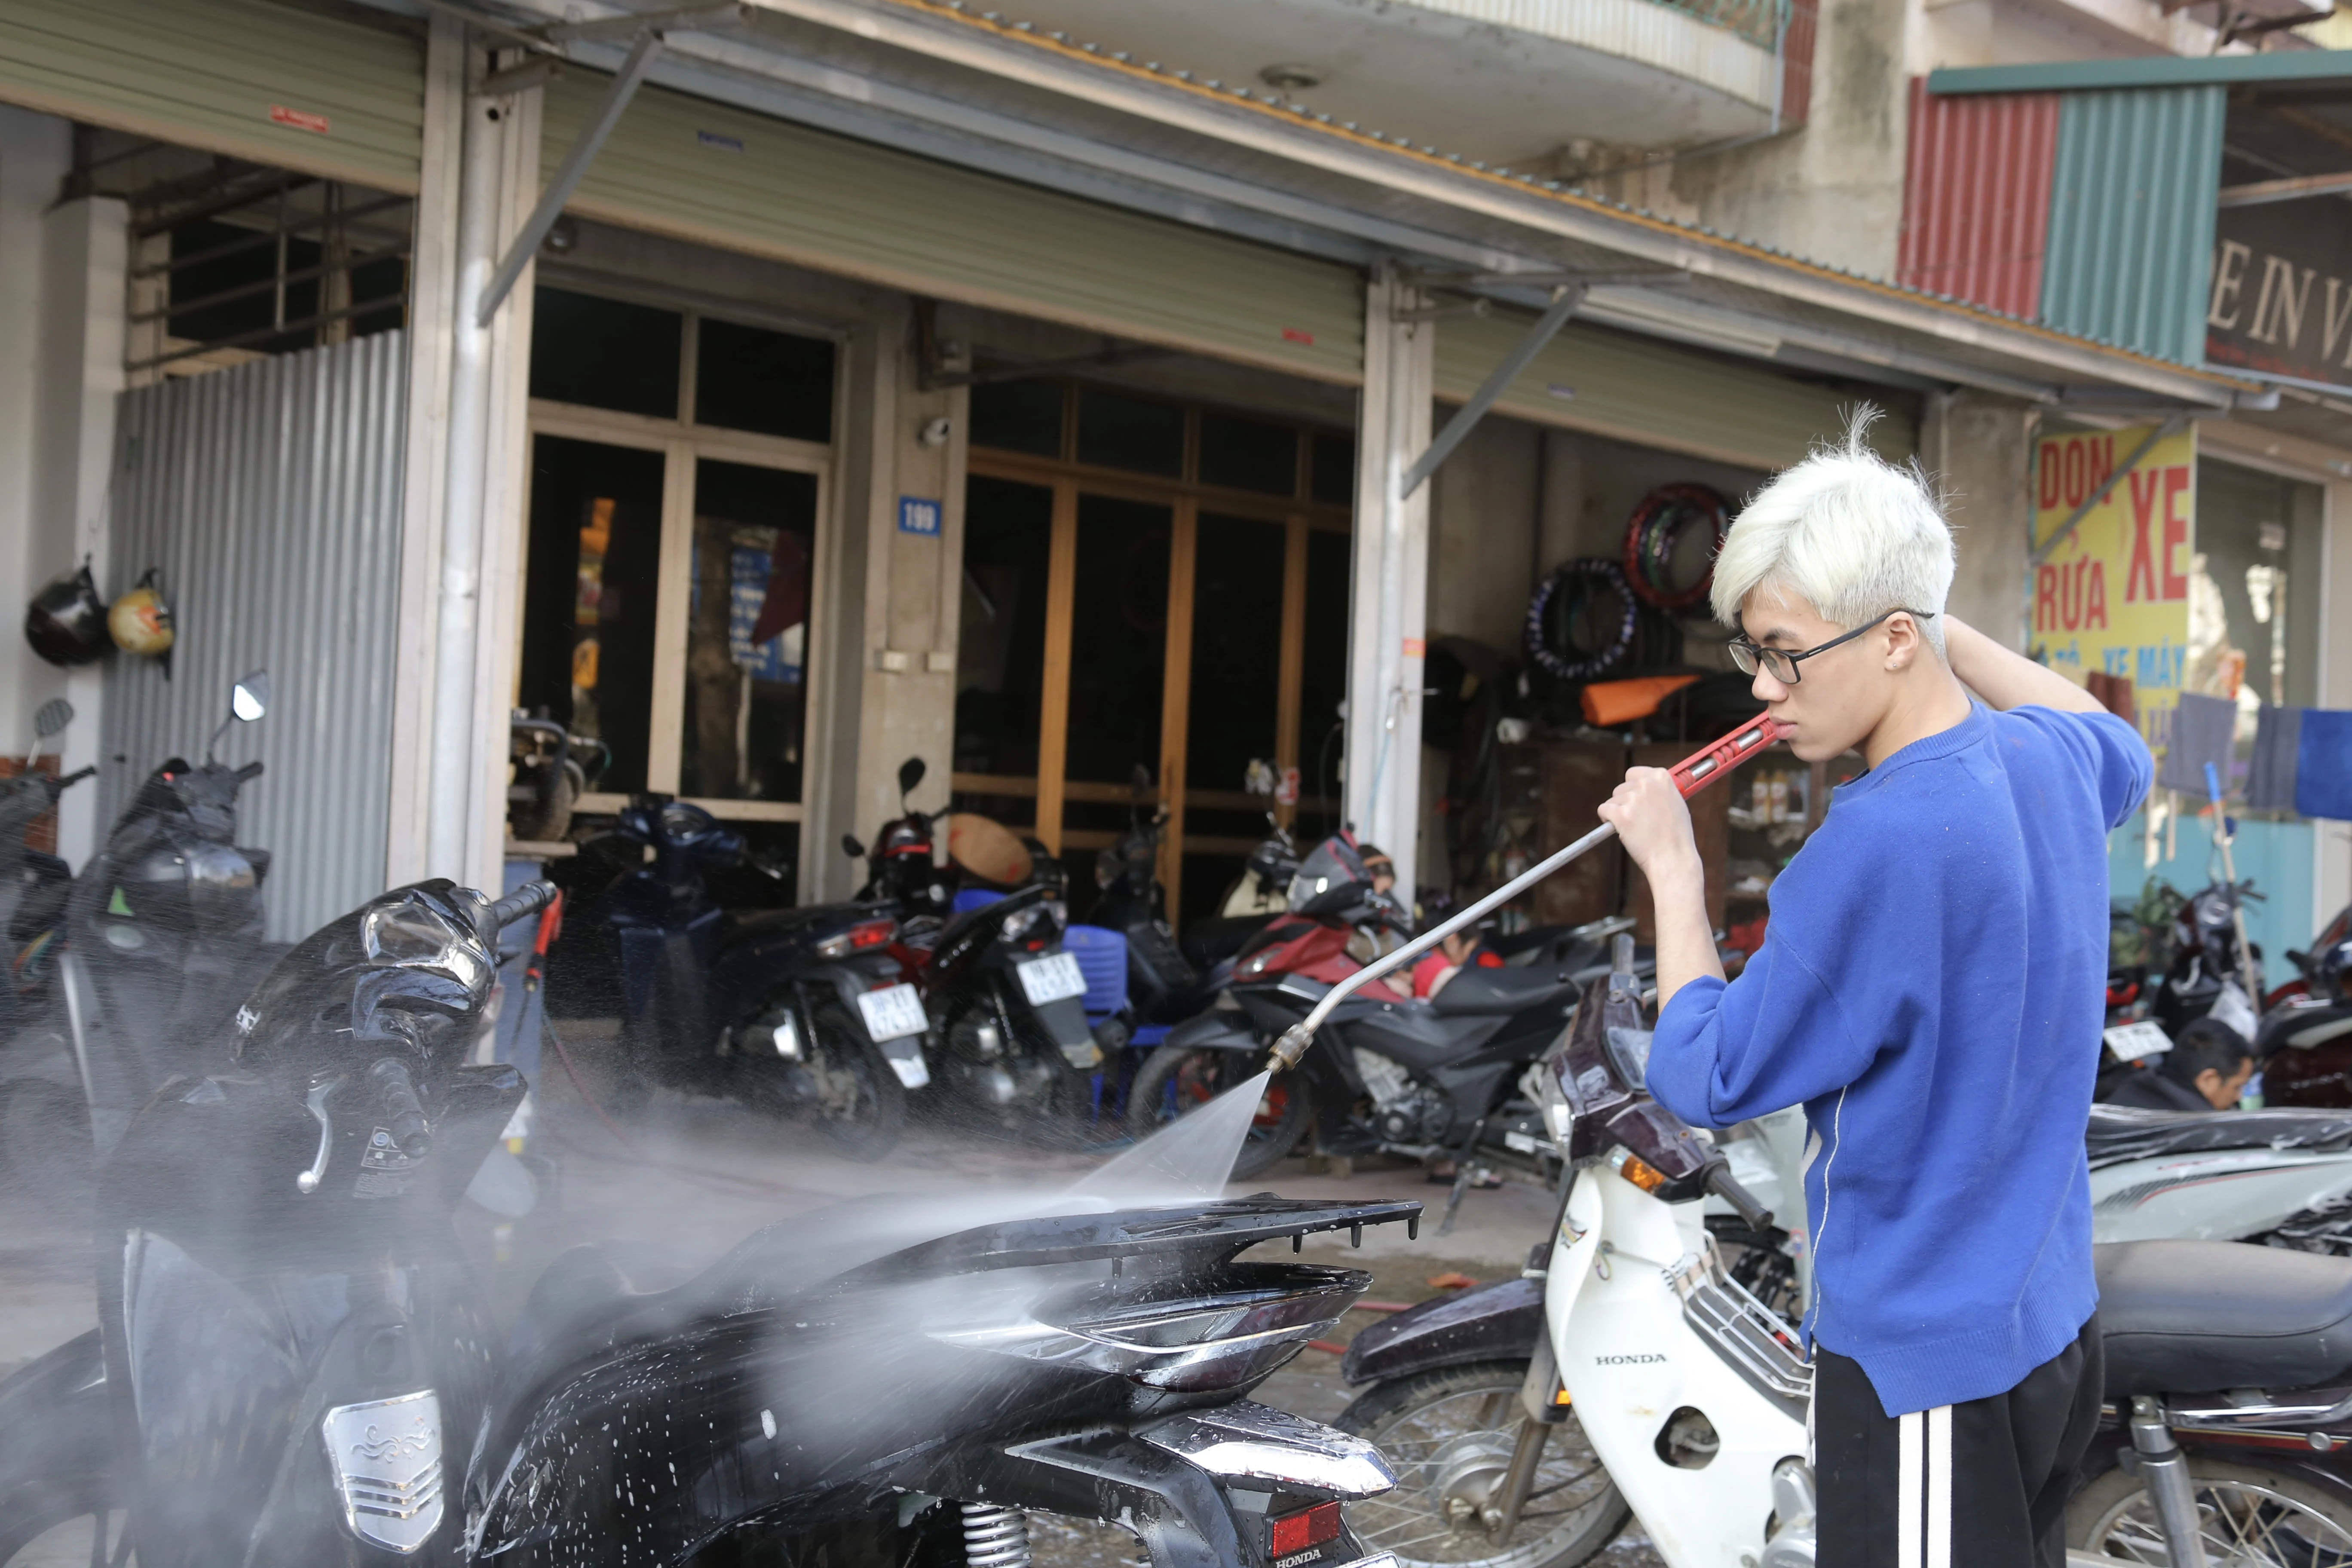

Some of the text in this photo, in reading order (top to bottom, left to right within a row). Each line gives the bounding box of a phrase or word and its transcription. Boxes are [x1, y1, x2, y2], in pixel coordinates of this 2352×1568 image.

[2207, 238, 2251, 330] E
[2321, 276, 2352, 371] V
[2125, 466, 2189, 603] XE
[1595, 1354, 1667, 1366] HONDA
[1276, 1549, 1322, 1568] HONDA
